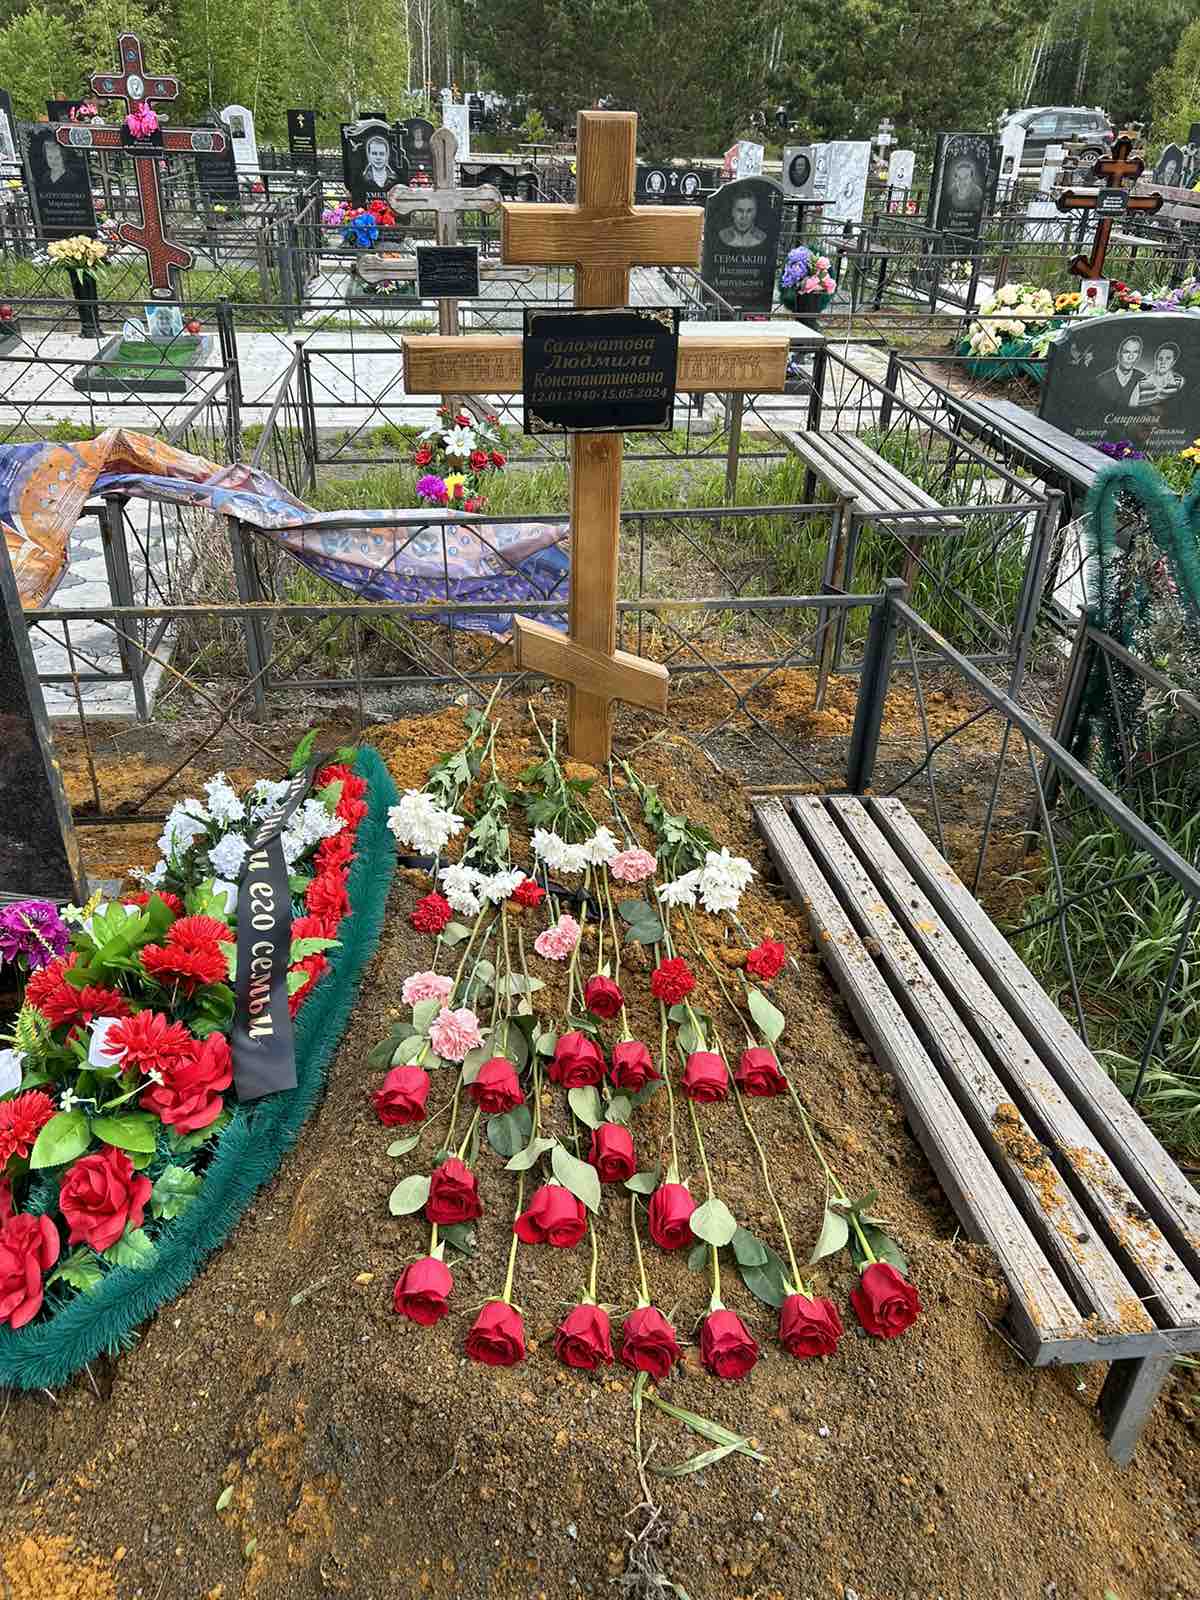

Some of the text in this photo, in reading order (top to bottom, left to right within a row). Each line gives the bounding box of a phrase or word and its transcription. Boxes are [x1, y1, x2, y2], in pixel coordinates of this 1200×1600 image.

[543, 337, 656, 353] Саламатова
[545, 353, 651, 369] Людмила
[533, 371, 664, 388] Константиновна
[1103, 413, 1161, 427] Смирновы
[248, 882, 275, 931] его
[248, 941, 275, 1039] семьи
